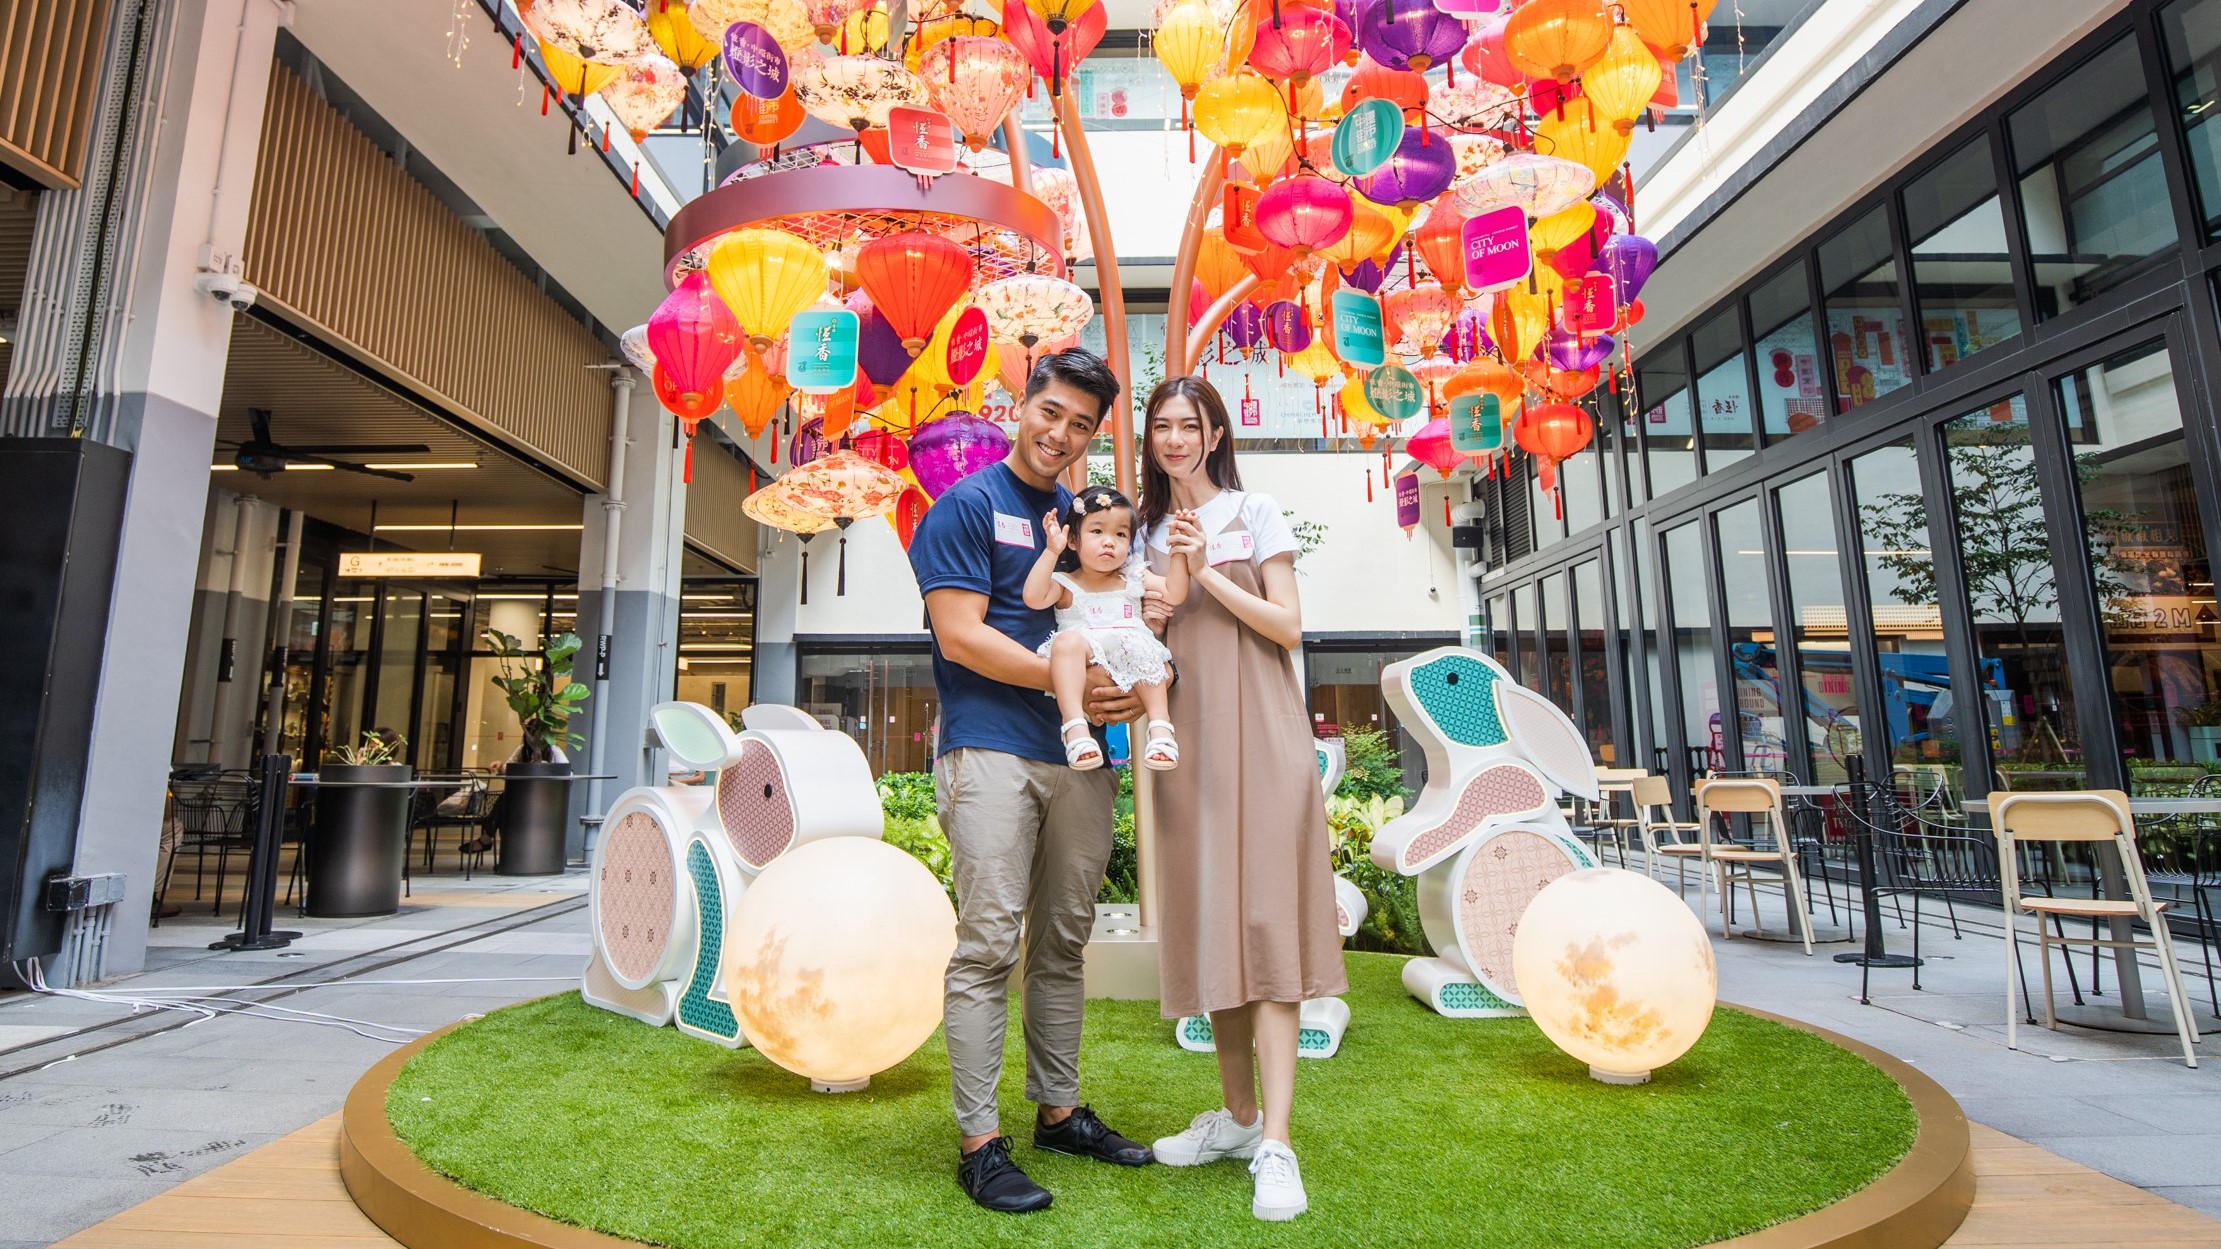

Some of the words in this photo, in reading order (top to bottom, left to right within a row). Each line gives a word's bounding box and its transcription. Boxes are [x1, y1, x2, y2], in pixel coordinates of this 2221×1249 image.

[1470, 236, 1494, 250] CITY
[1472, 247, 1485, 260] OF
[1487, 239, 1519, 255] MOON
[1340, 313, 1358, 325] CITY
[1341, 323, 1352, 332] OF
[1353, 325, 1377, 337] MOON
[350, 555, 360, 567] G
